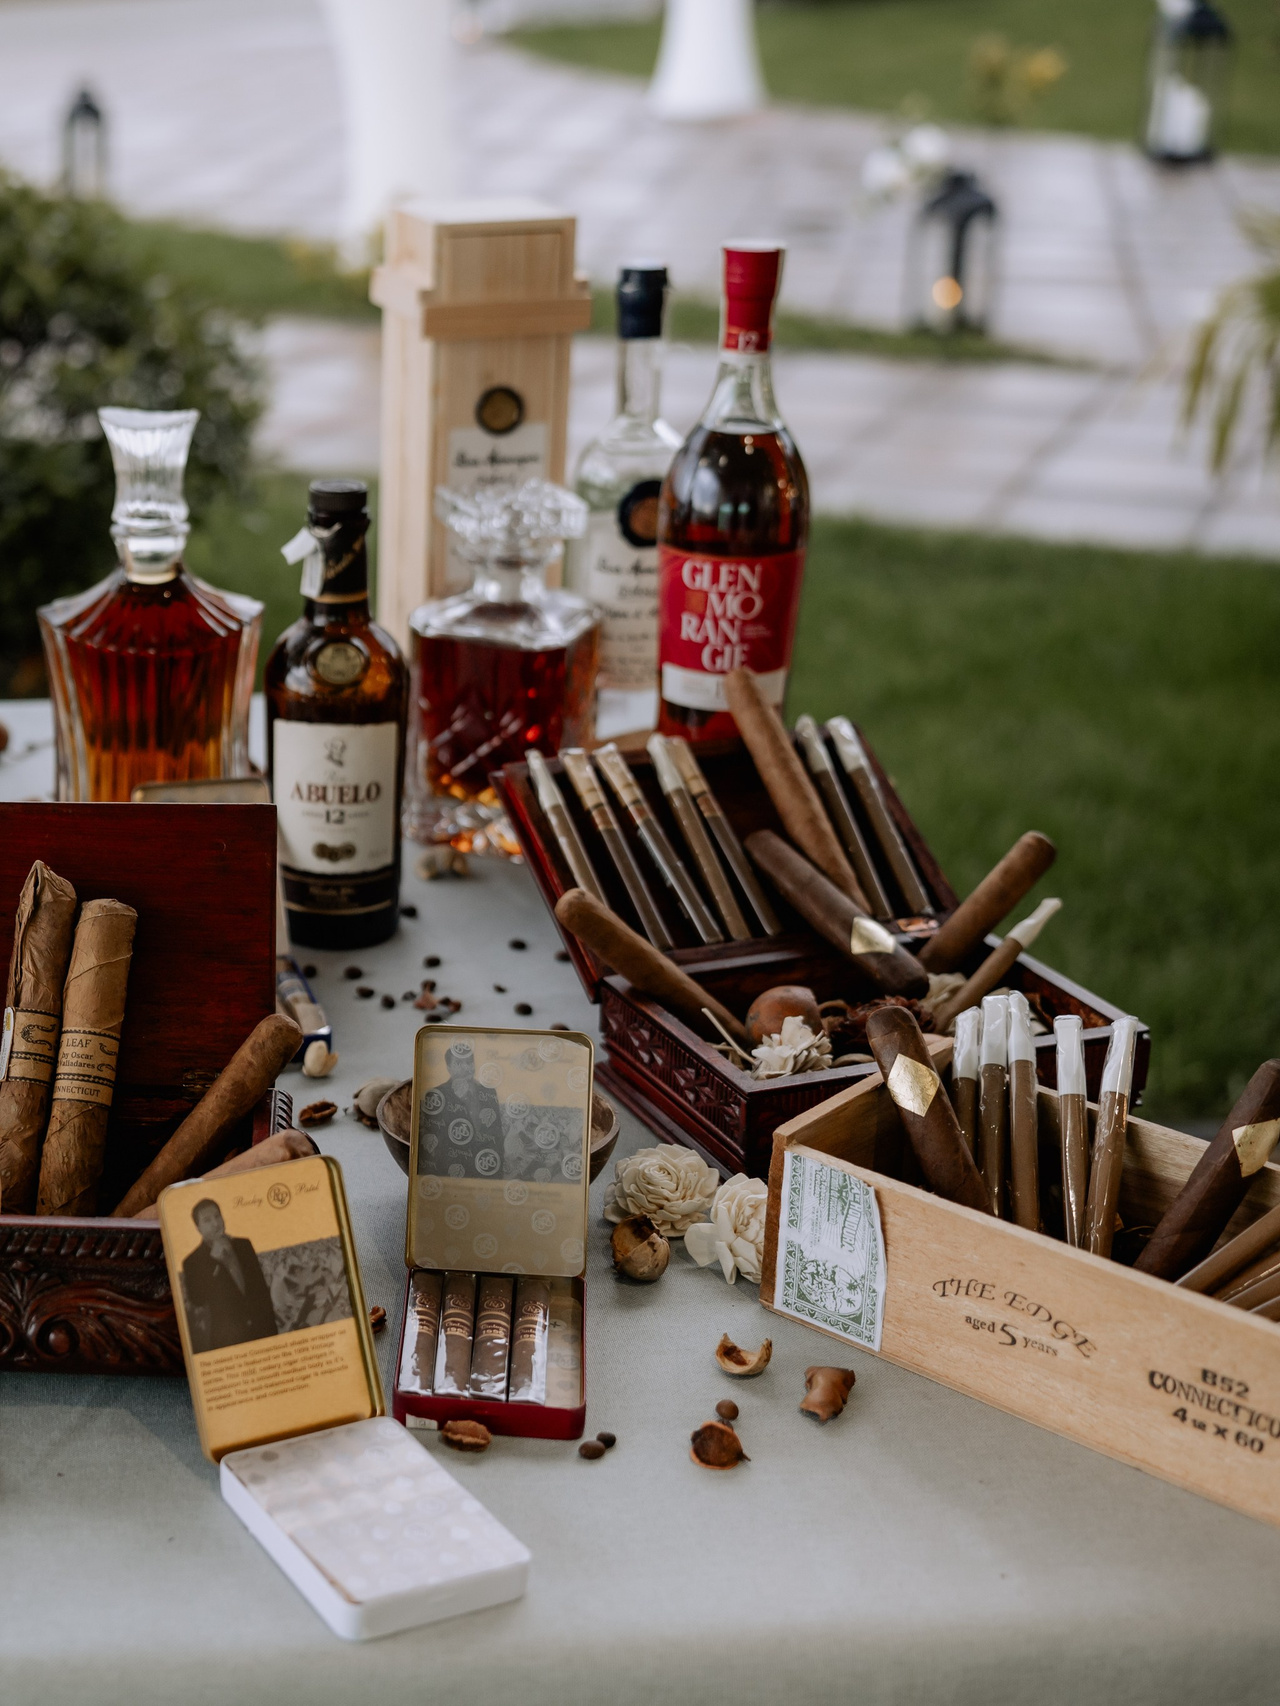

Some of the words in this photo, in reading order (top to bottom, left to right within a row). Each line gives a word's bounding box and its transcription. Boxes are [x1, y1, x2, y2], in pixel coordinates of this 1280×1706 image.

[738, 331, 759, 353] 12
[681, 558, 763, 593] GLEN
[705, 582, 764, 621] MO
[680, 611, 742, 645] RAN
[291, 780, 382, 806] ABUELO
[324, 809, 346, 825] 12
[66, 1038, 92, 1048] LEAF
[71, 1052, 94, 1060] Oscar
[54, 1085, 100, 1097] NNECTICUT
[841, 1200, 862, 1253] HONDURA
[932, 1278, 996, 1300] THE
[1004, 1291, 1098, 1358] EDGE
[965, 1315, 996, 1333] aged
[998, 1323, 1019, 1346] 5
[1023, 1336, 1058, 1356] years
[1201, 1367, 1250, 1399] B52
[1148, 1369, 1280, 1439] CONNECTICU
[1172, 1407, 1187, 1423] 4
[1235, 1431, 1265, 1454] 60
